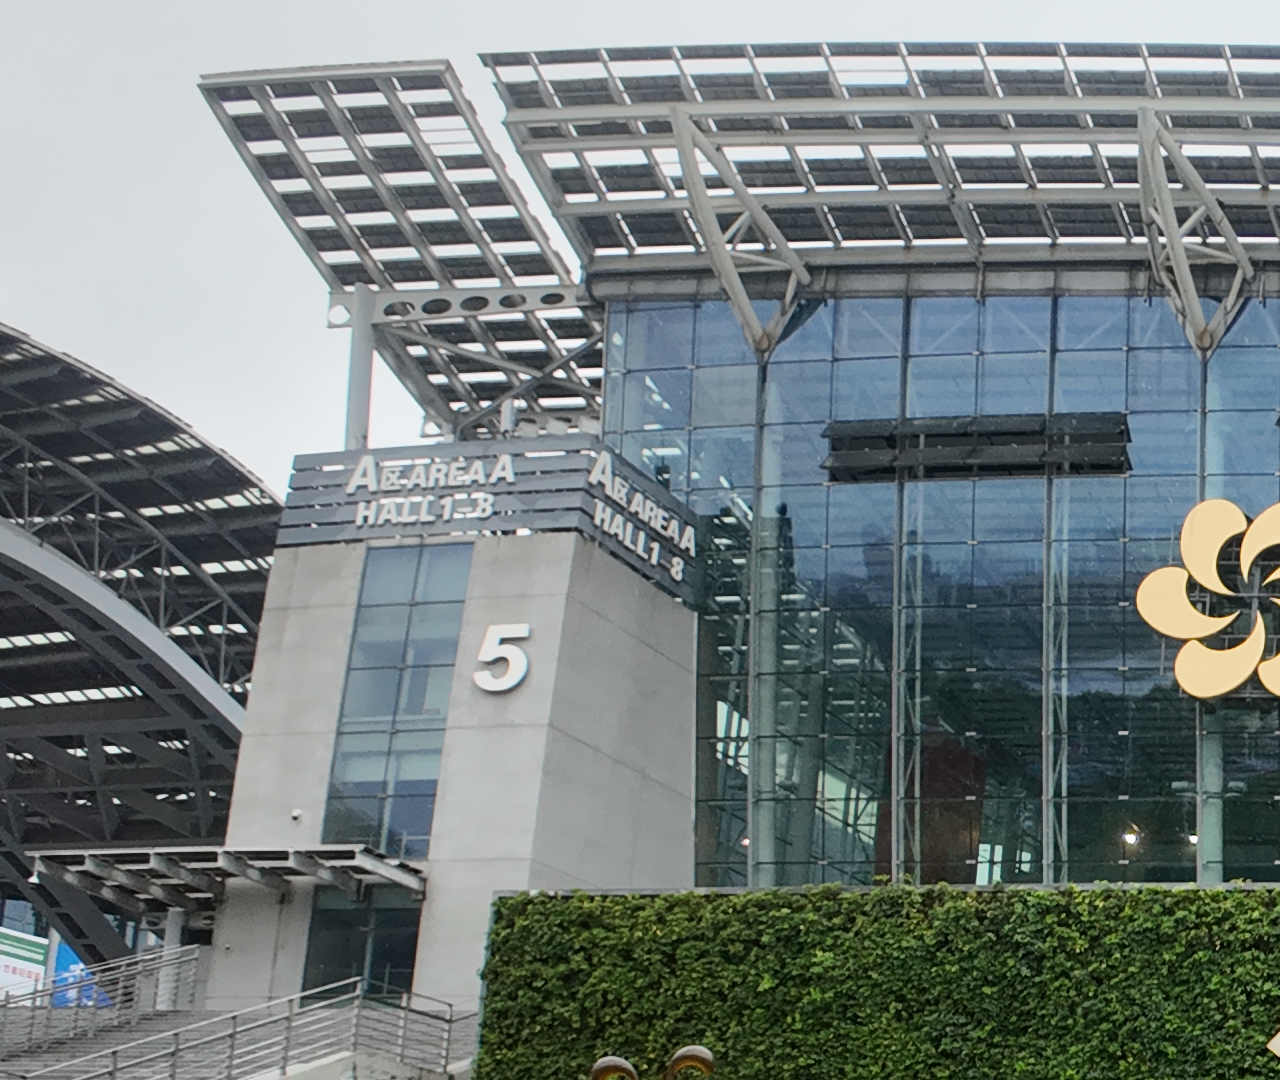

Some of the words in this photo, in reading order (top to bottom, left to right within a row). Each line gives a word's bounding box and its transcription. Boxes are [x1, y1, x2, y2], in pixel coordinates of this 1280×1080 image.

[406, 459, 488, 490] AREA
[354, 498, 437, 527] HALL
[594, 498, 649, 560] HALL
[629, 492, 681, 545] AREA
[472, 622, 531, 693] 5
